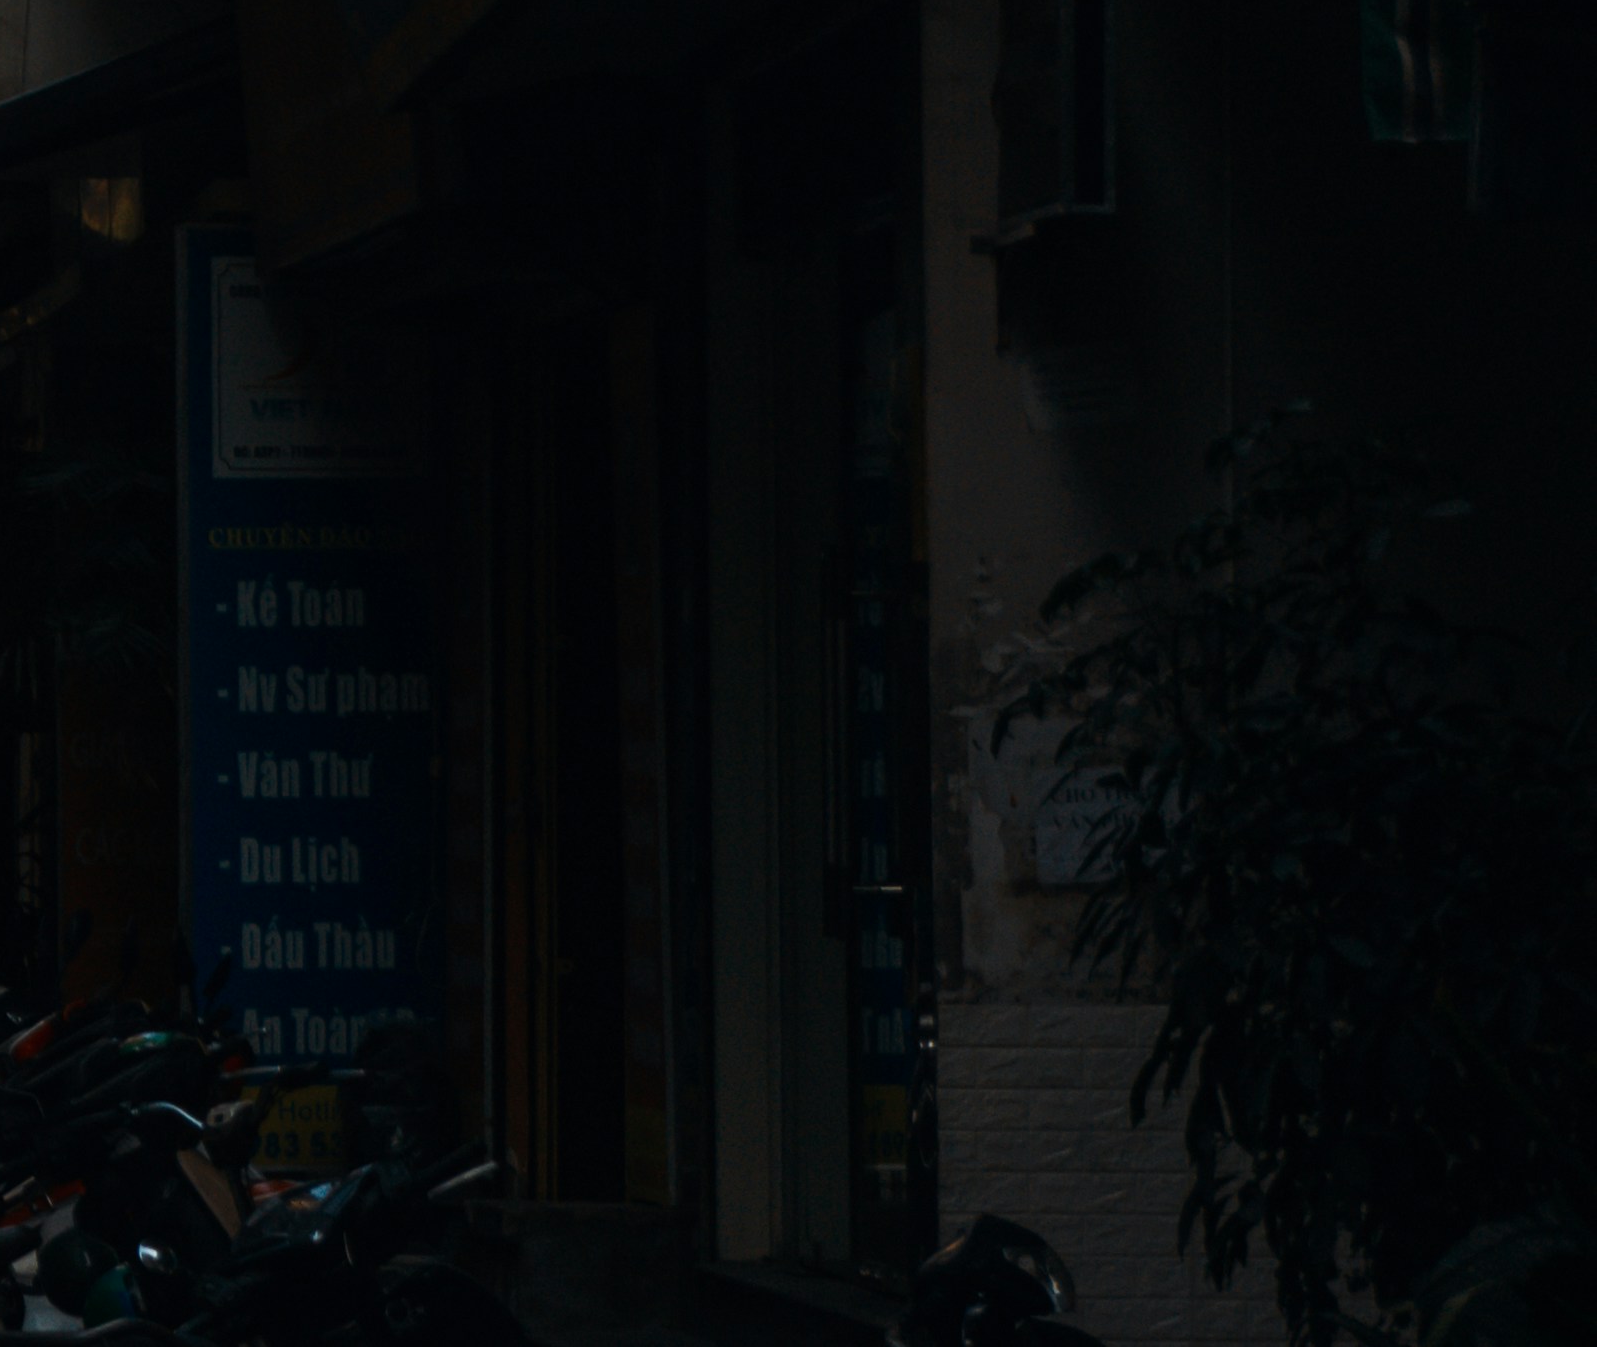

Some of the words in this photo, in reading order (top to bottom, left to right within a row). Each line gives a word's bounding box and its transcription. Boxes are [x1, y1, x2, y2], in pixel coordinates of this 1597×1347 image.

[237, 575, 279, 627] Kế
[288, 578, 366, 627] Toán
[238, 666, 277, 712] Nv
[336, 671, 429, 719] phạm
[237, 751, 300, 797] Văn
[310, 751, 373, 797] Thư
[240, 837, 282, 883] Du
[292, 837, 360, 891] Lịch
[241, 1008, 280, 1055] An
